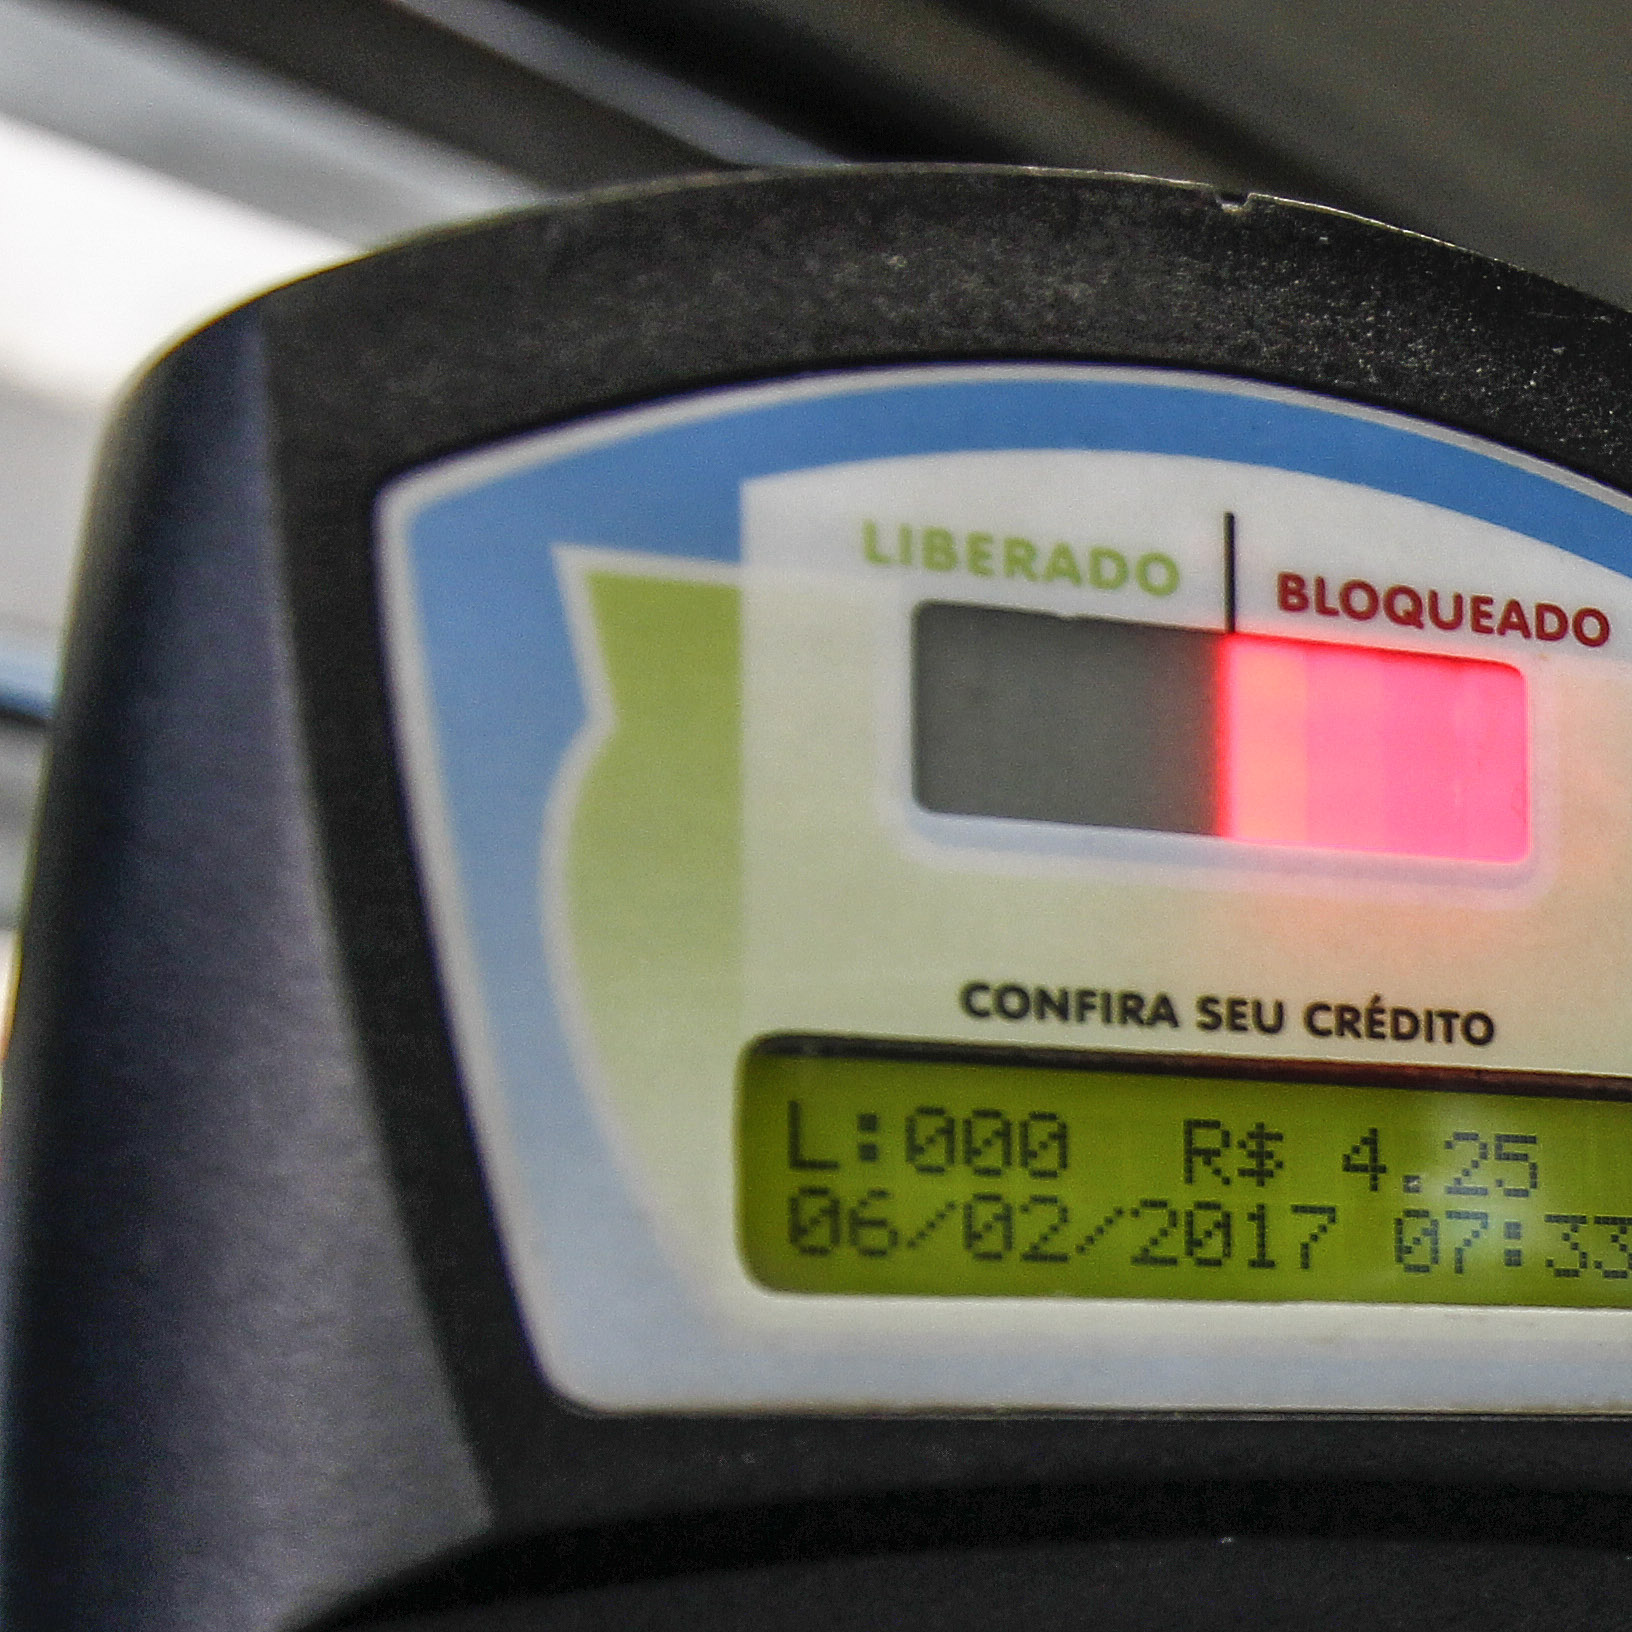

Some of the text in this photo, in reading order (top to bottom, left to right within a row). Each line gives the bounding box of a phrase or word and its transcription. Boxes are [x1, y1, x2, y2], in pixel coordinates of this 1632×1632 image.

[863, 521, 1181, 598] LIBERADO
[1276, 572, 1612, 648] BLOQUEADO
[959, 980, 1497, 1047] CONFIRA SEU CRÉDITO
[787, 1100, 1540, 1198] L:000 R$ 4.25
[786, 1187, 1338, 1270] 06/02/2017
